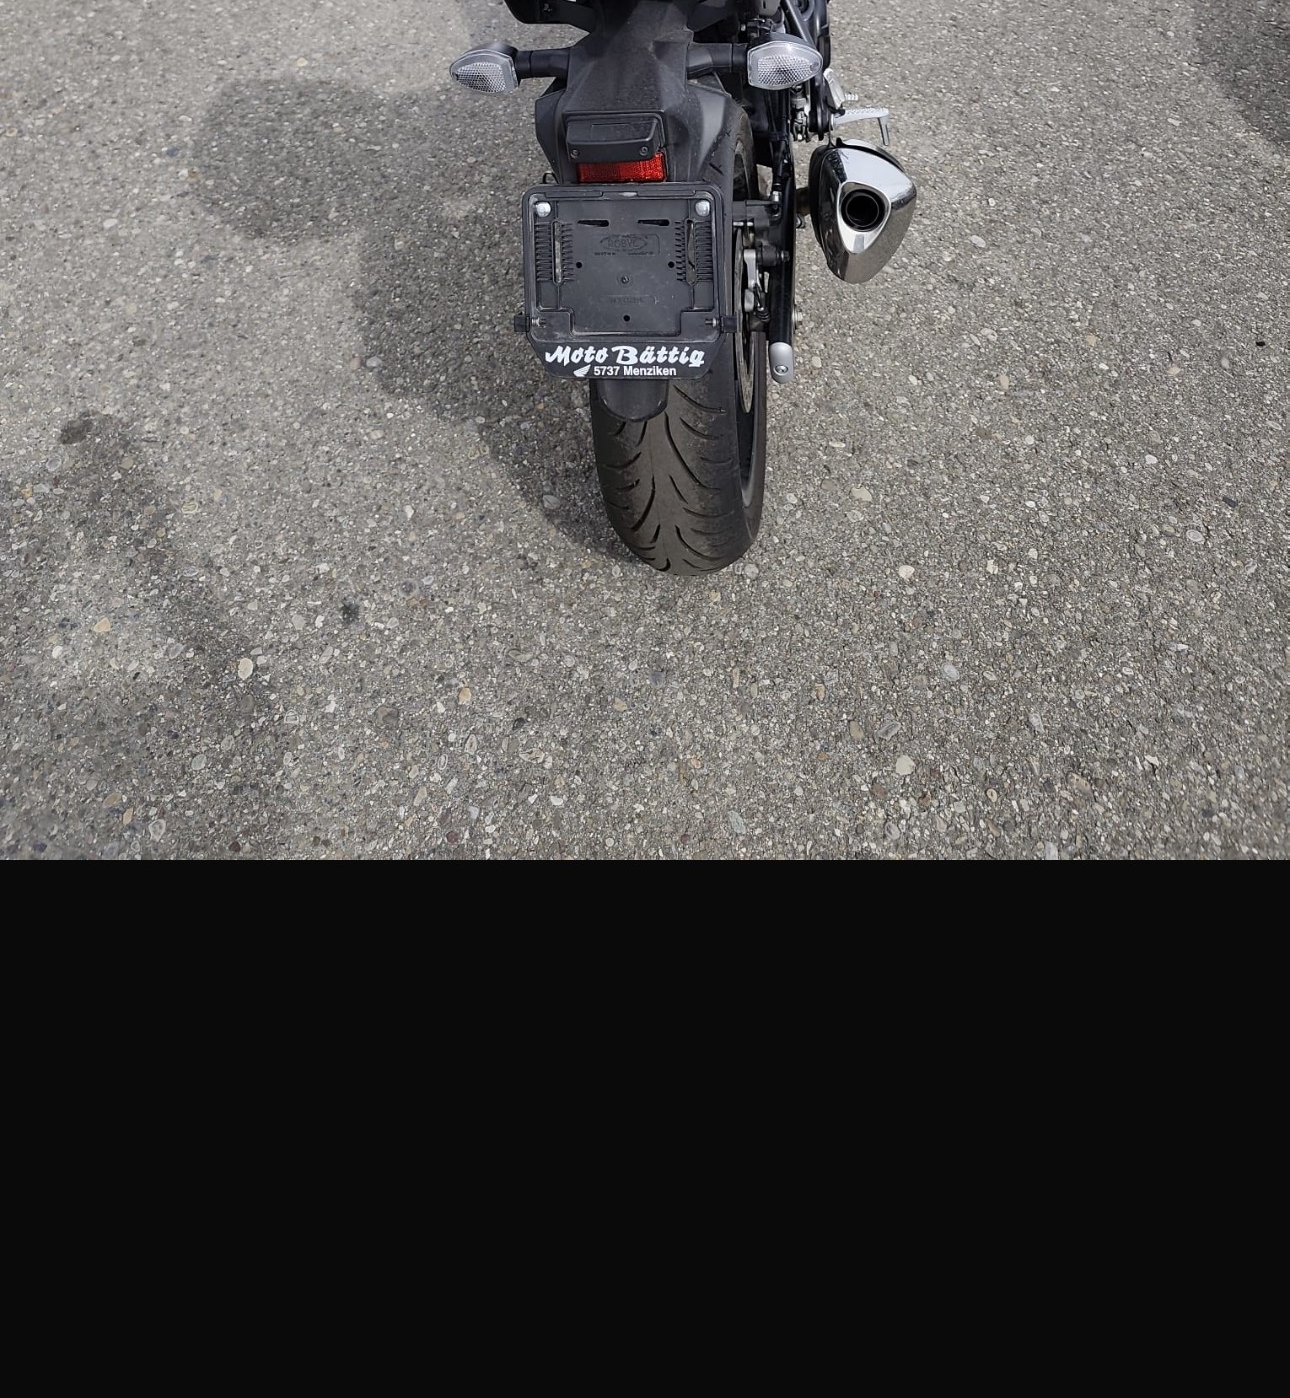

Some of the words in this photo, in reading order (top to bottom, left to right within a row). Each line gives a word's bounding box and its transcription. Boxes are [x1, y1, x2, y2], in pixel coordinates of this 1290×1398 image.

[545, 345, 608, 366] Moto
[611, 345, 705, 368] Bättig
[593, 366, 621, 376] 5737
[623, 365, 677, 376] Menziken
